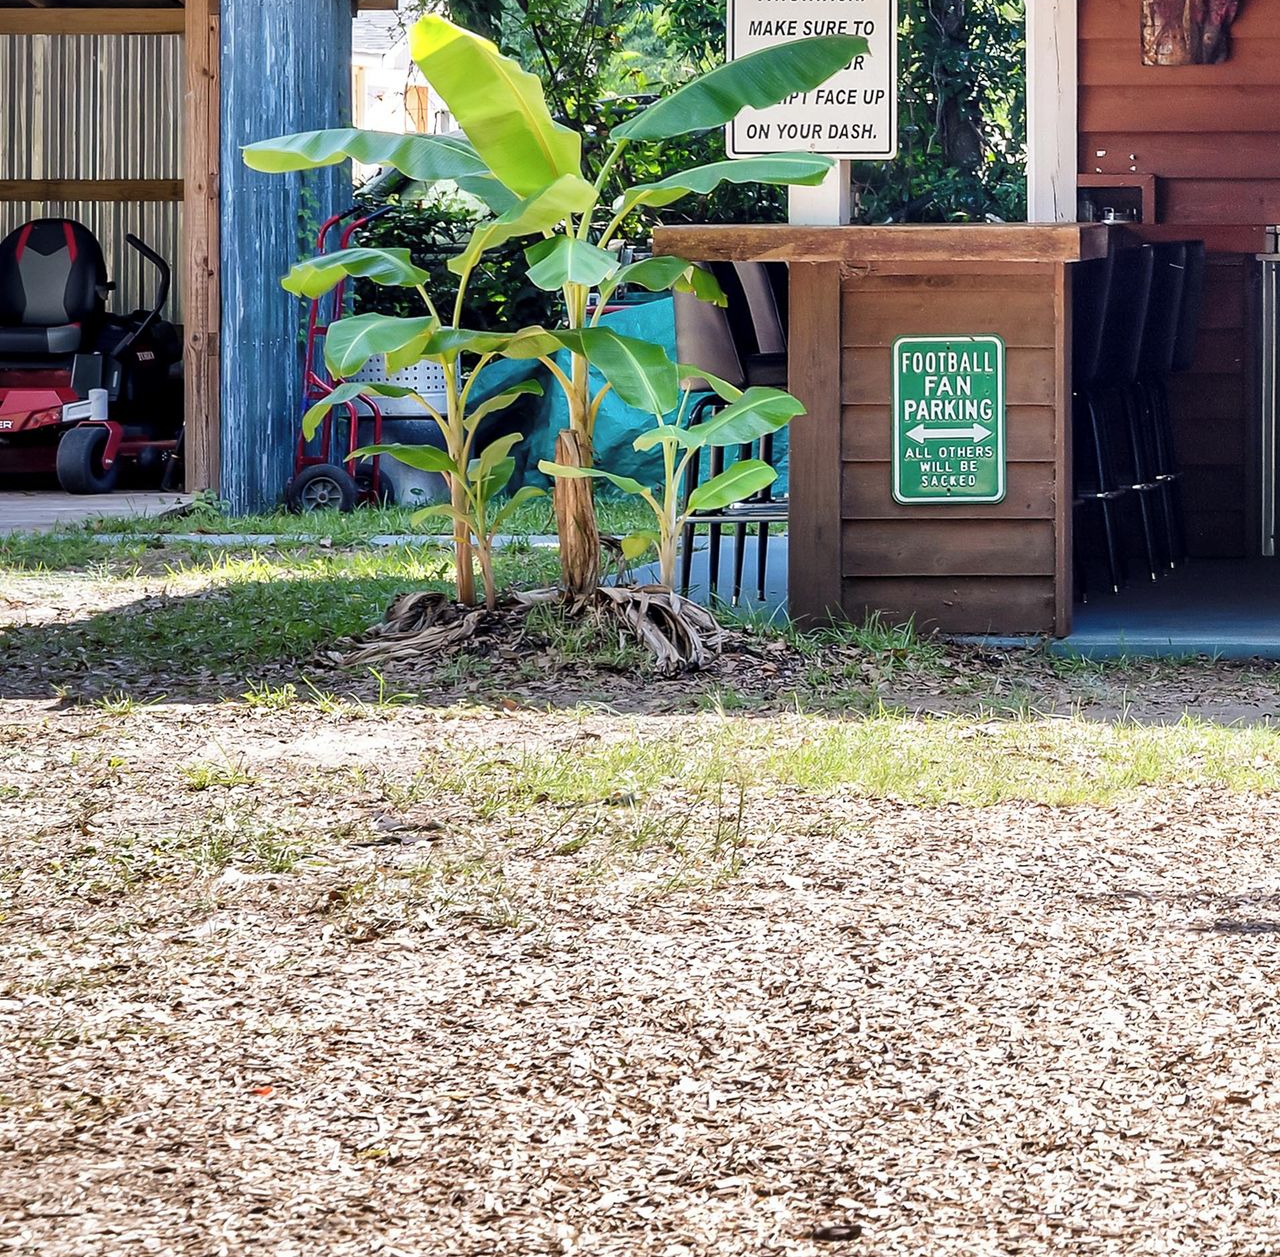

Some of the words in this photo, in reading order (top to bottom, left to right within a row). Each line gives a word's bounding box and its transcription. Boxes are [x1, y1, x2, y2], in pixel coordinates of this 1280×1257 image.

[748, 20, 797, 36] MAKE
[802, 20, 848, 36] SURE
[853, 20, 875, 35] TO
[815, 90, 857, 105] FACE
[863, 90, 885, 105] UP
[746, 124, 770, 139] ON
[777, 124, 822, 139] YOUR
[828, 124, 877, 139] DASH.
[902, 352, 993, 373] FOOTBALL
[924, 376, 971, 396] FAN
[904, 399, 993, 420] PARKING
[905, 447, 932, 458] ALL
[938, 446, 993, 458] OTHERS
[920, 461, 953, 472] WILL
[960, 461, 978, 472] BE
[921, 475, 976, 486] SACKED
